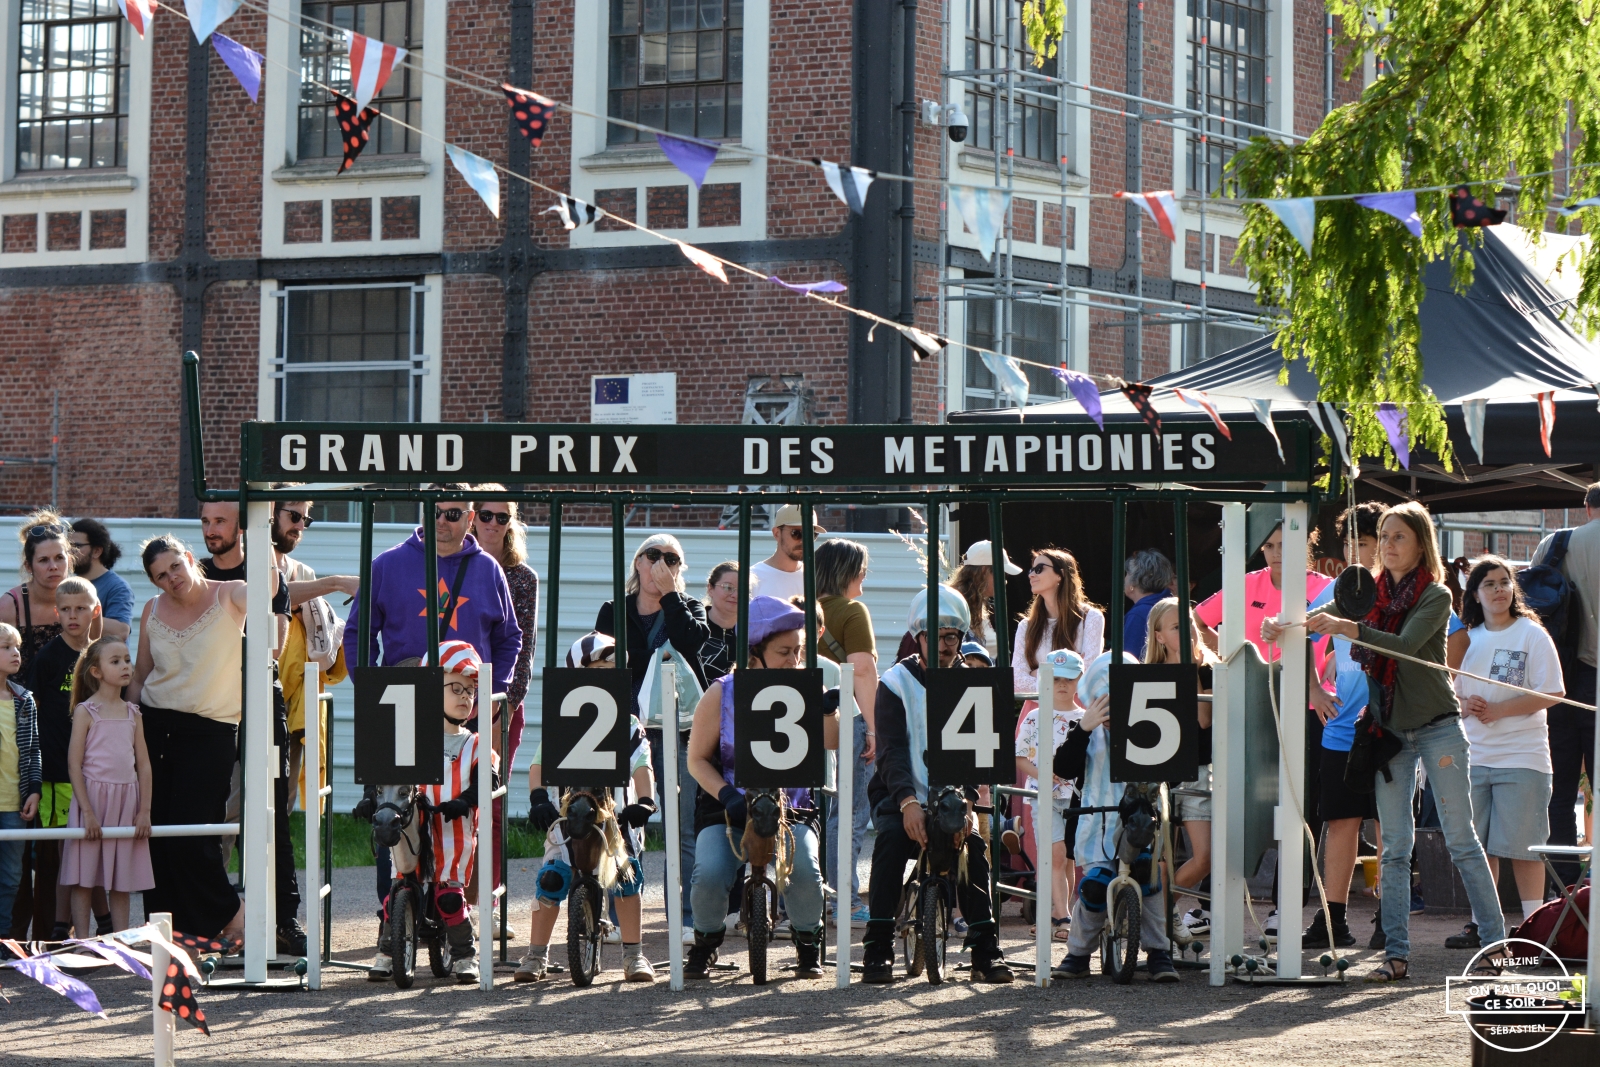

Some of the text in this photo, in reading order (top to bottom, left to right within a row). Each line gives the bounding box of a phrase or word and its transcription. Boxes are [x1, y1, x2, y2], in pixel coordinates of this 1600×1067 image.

[280, 433, 1215, 475] GRAND PRIX DES METAPHONIES
[1250, 600, 1267, 610] NIKE
[378, 684, 416, 767] 1
[556, 685, 618, 770] 2
[750, 684, 809, 771] 3
[941, 686, 1000, 768] 4
[1125, 681, 1181, 766] 5
